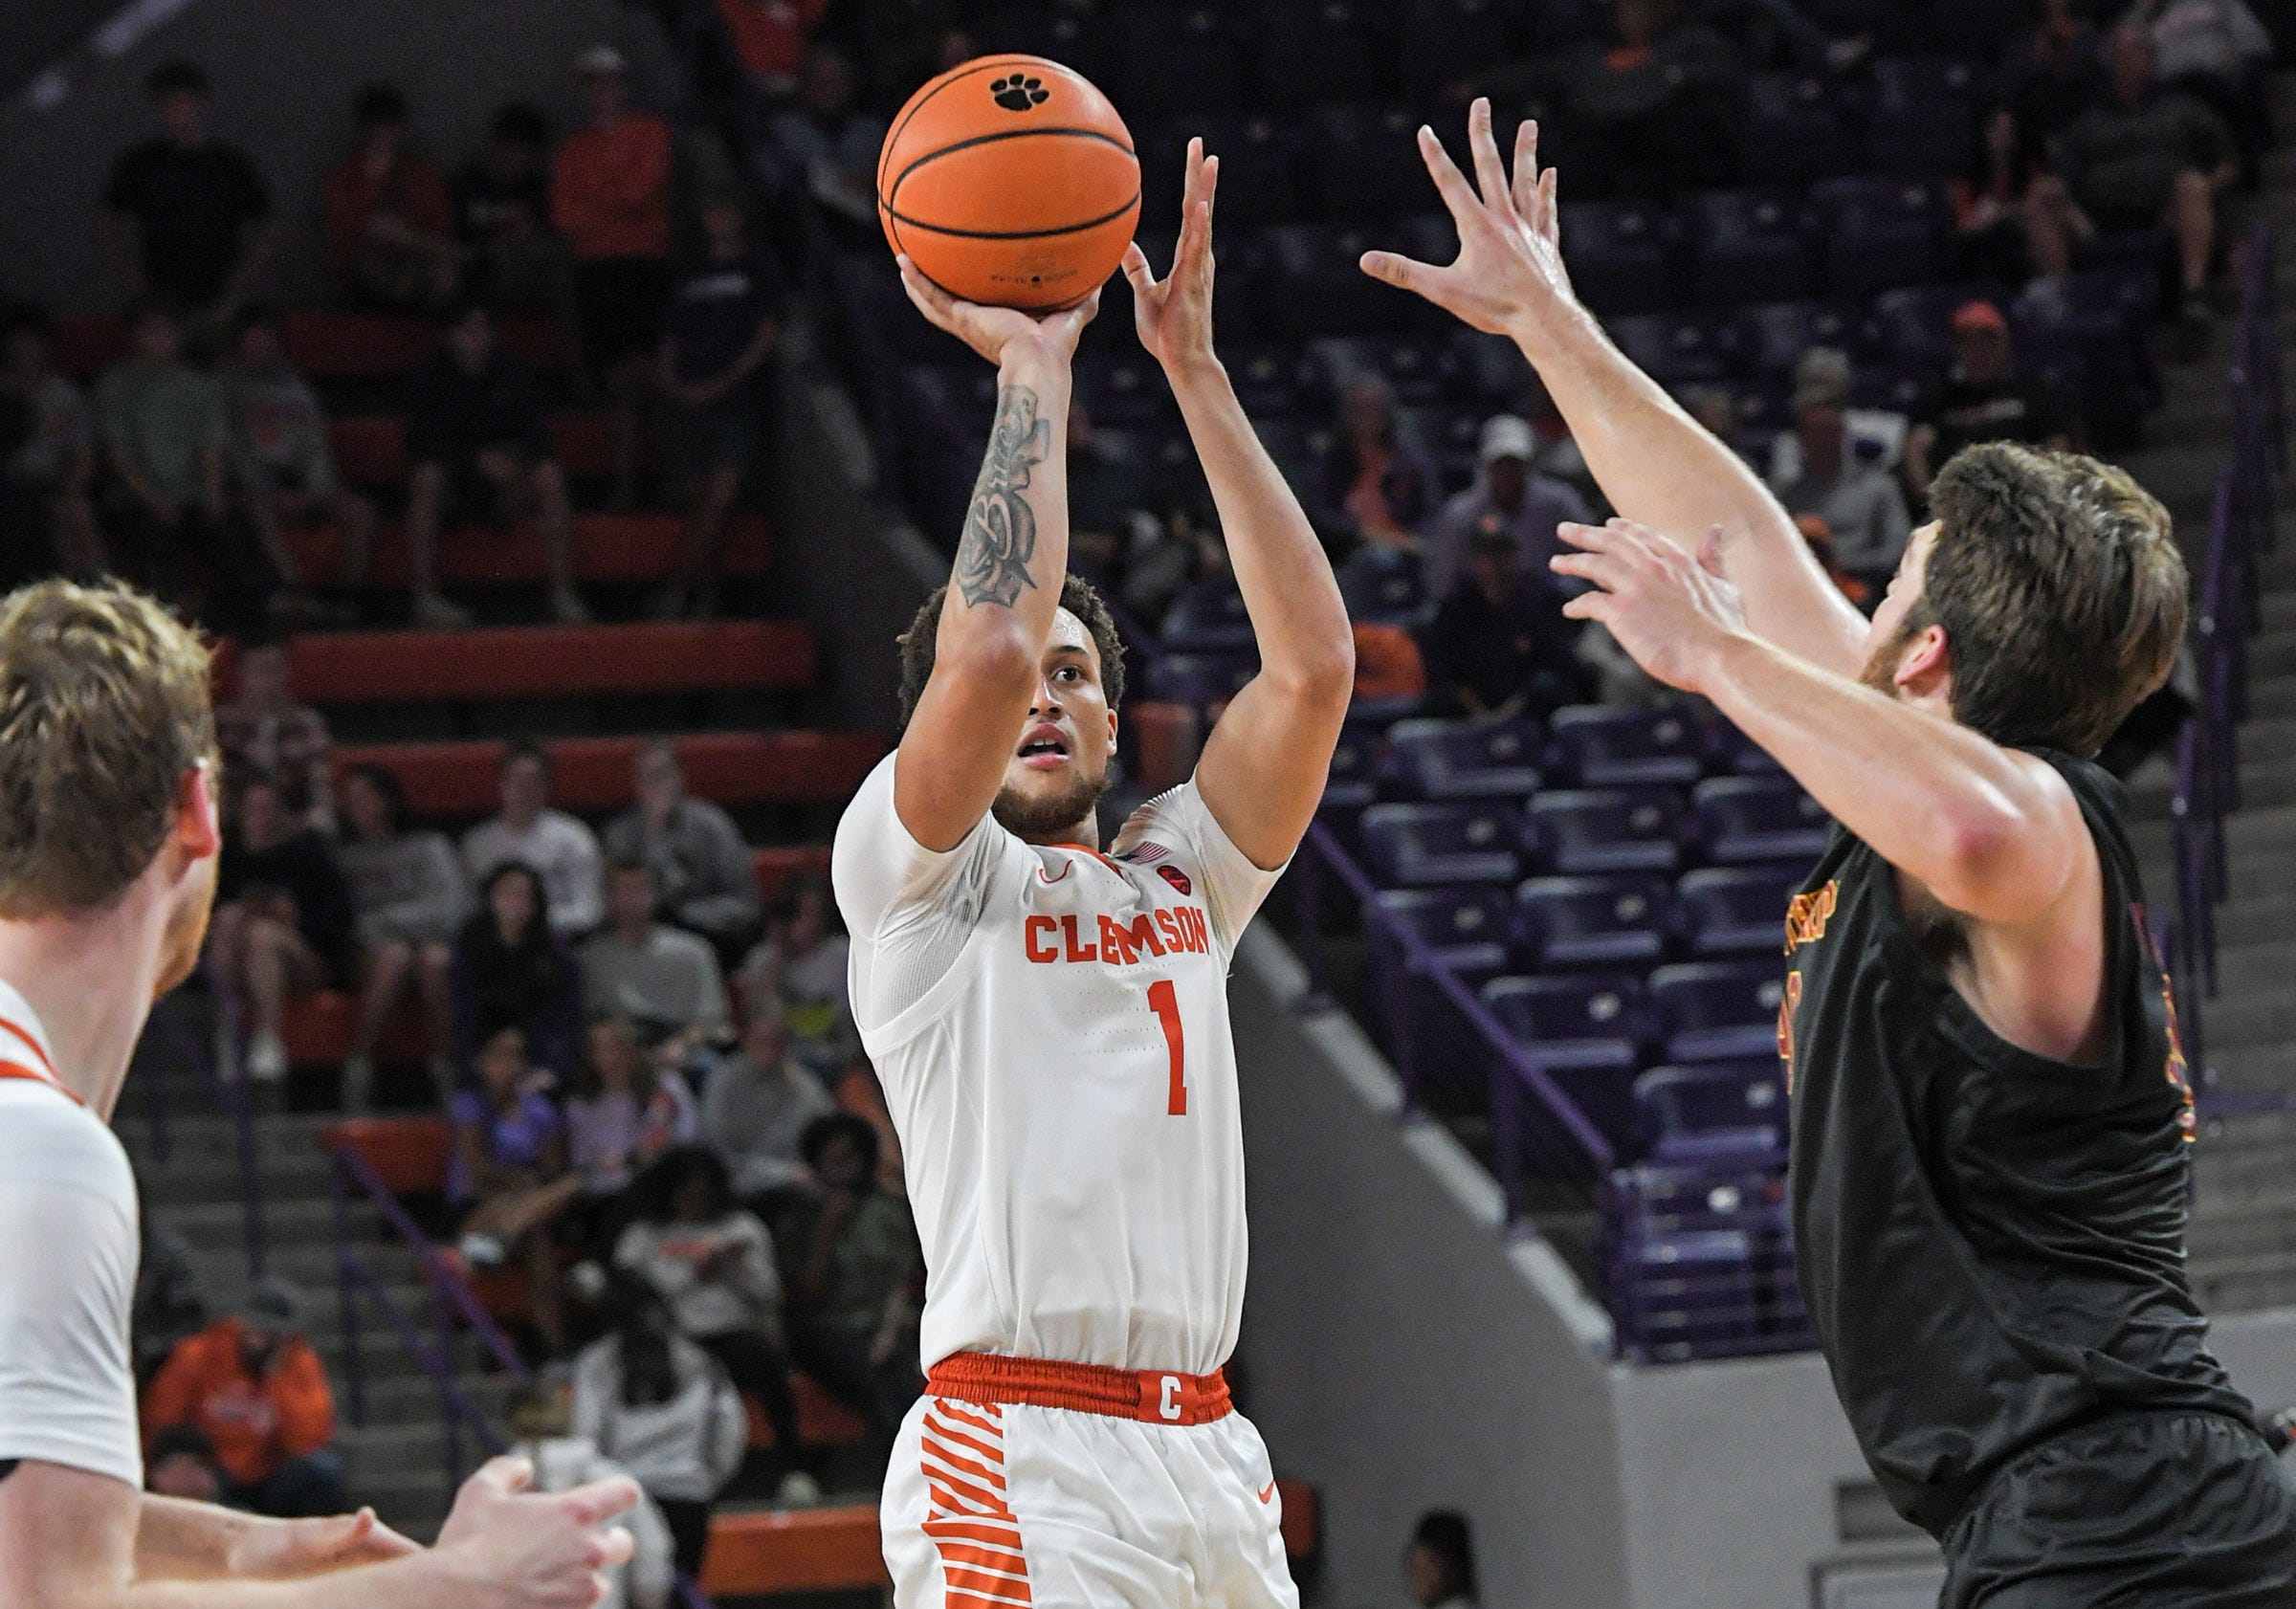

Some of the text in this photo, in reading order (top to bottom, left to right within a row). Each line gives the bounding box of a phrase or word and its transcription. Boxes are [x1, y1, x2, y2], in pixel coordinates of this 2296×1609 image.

[1025, 906, 1209, 965] CLEMSON
[1147, 980, 1187, 1115] 1
[1159, 1375, 1181, 1420] C
